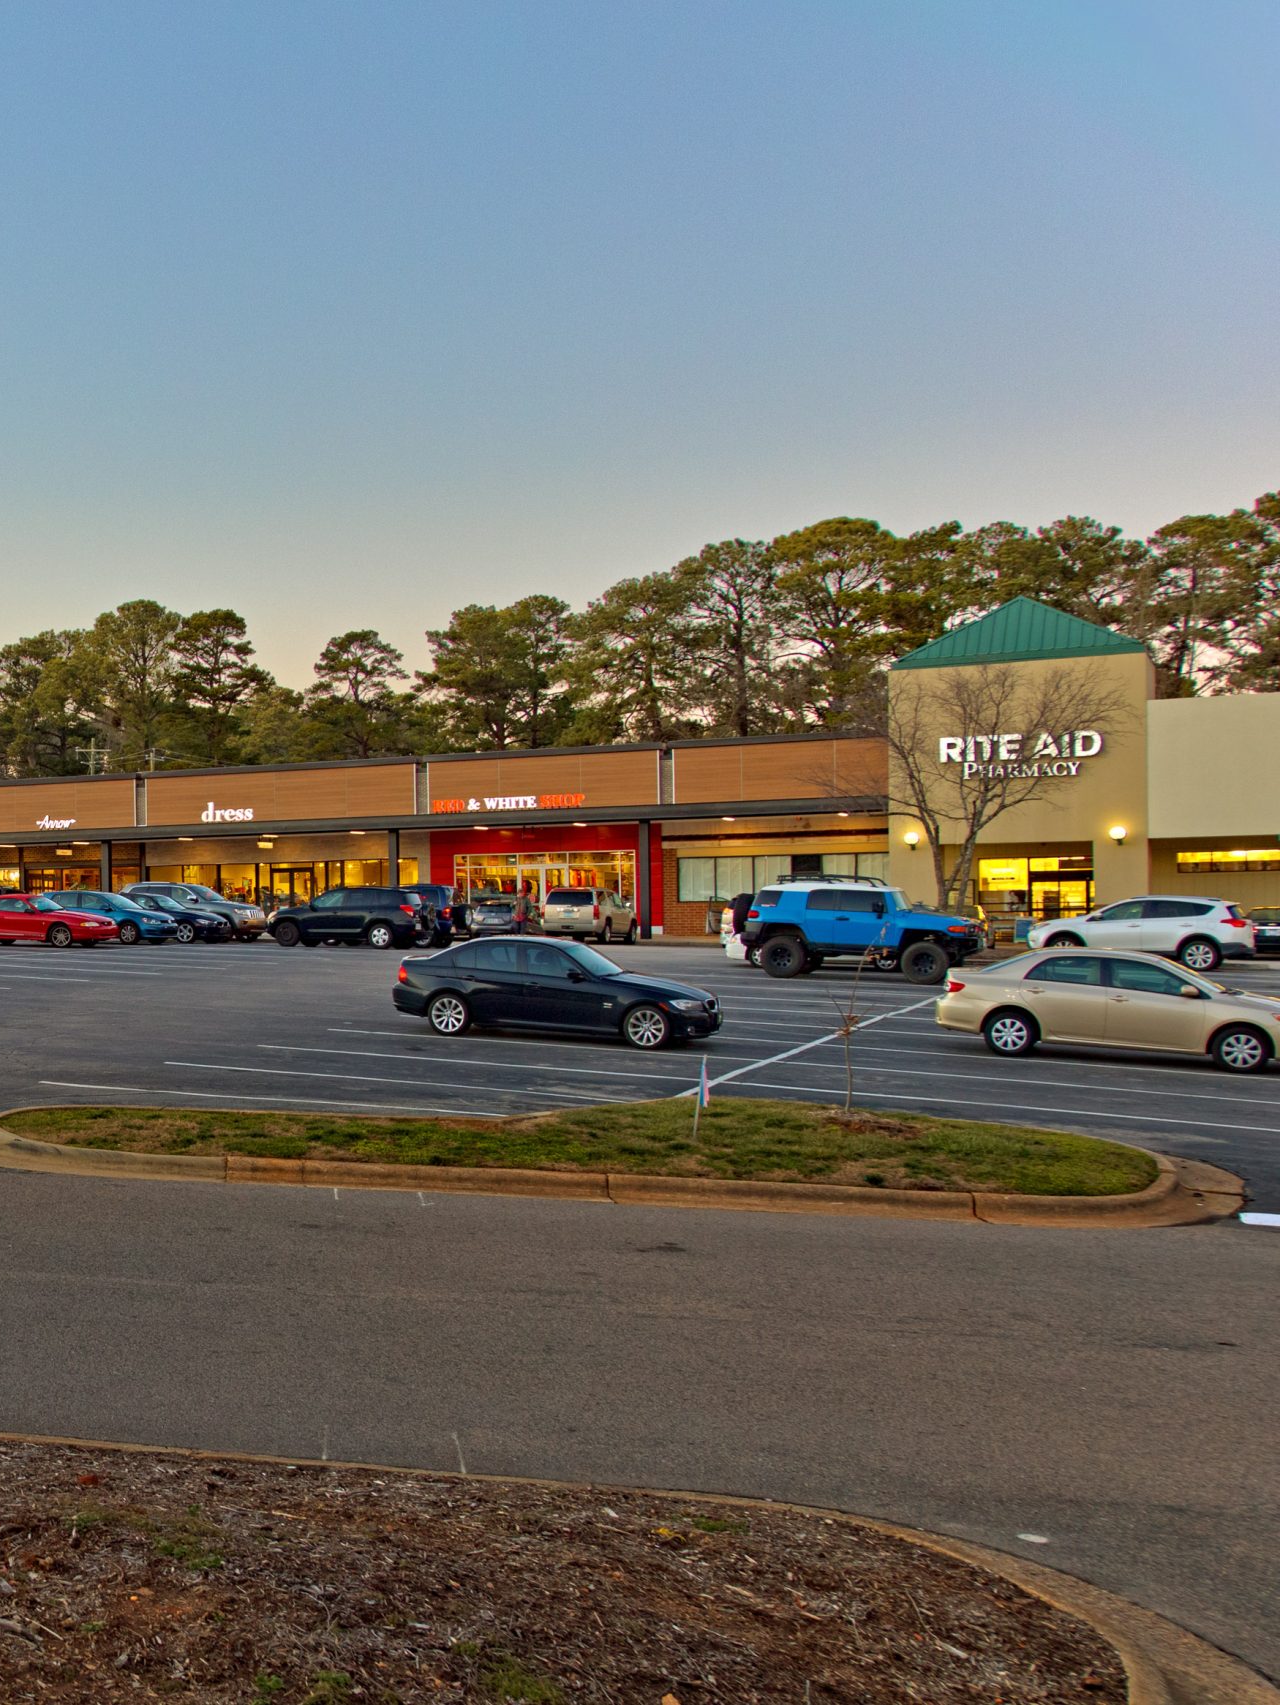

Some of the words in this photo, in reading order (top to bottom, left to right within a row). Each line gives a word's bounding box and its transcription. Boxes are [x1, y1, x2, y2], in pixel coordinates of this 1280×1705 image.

[938, 733, 1022, 763] RITE
[1033, 730, 1103, 759] AID
[963, 761, 1081, 780] PHARMACY
[201, 801, 254, 823] dress
[432, 799, 465, 813] RED
[467, 798, 481, 811] &
[483, 796, 537, 810] WHITE
[539, 794, 585, 808] SHOP
[36, 814, 76, 830] Arrow
